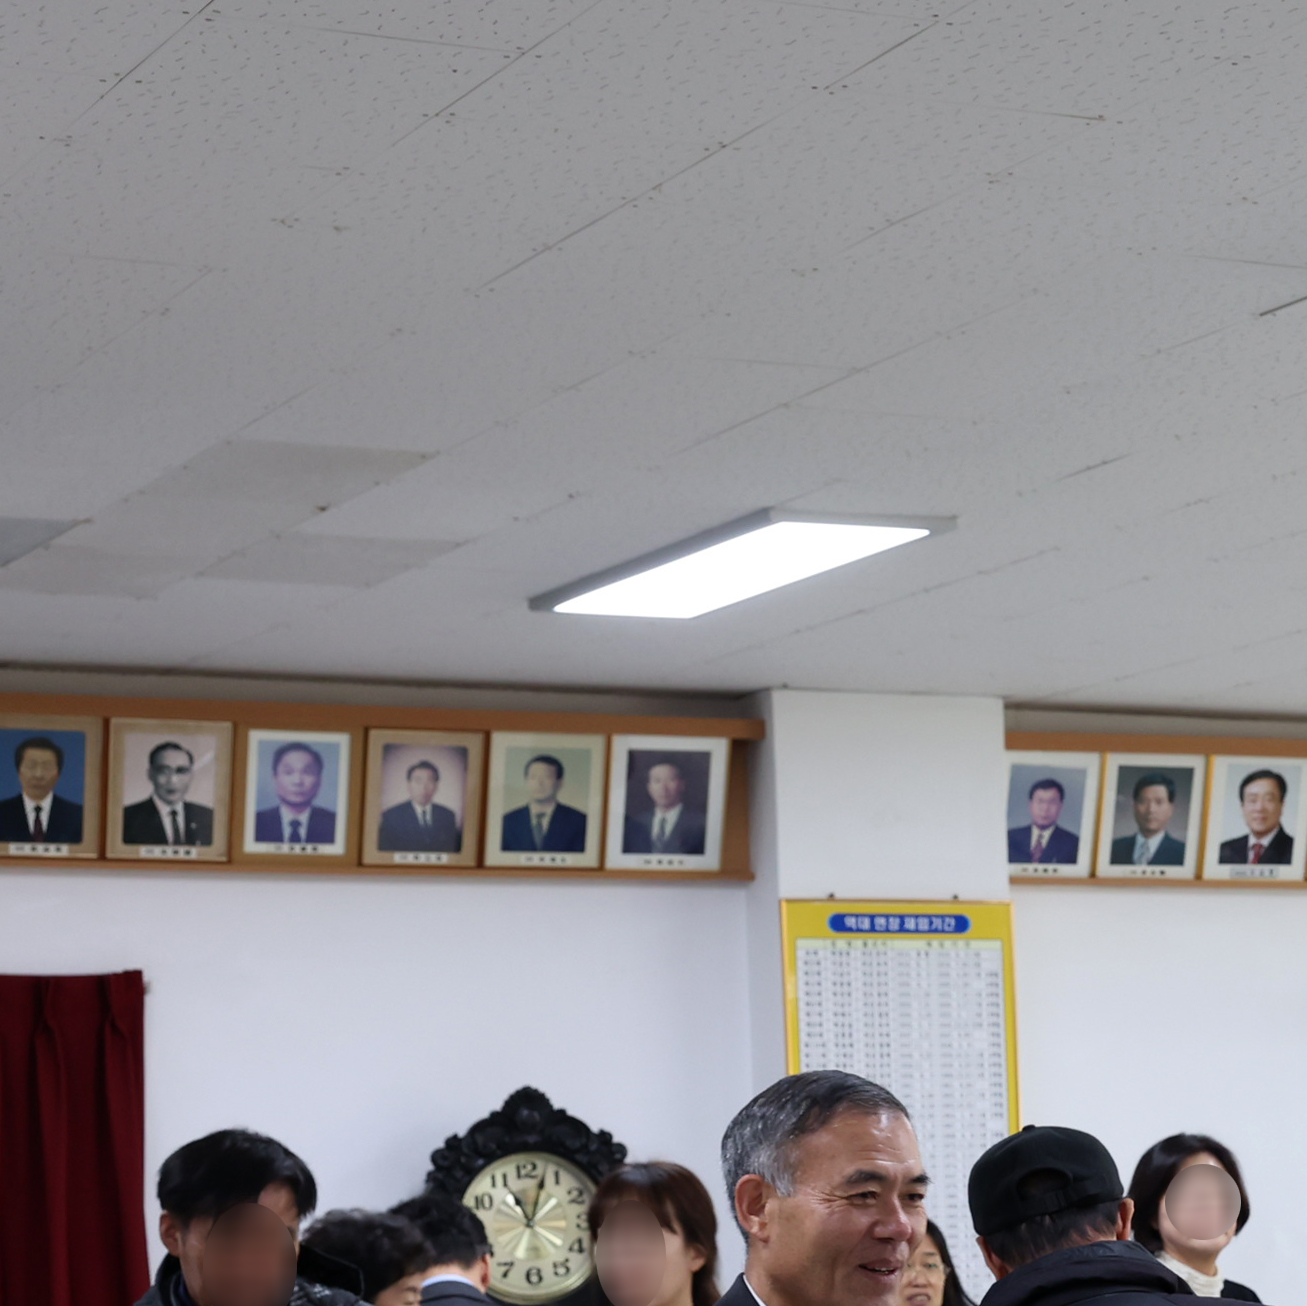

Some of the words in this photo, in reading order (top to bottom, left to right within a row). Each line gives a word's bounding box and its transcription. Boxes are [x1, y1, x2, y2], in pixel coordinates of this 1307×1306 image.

[515, 1162, 537, 1179] 12
[553, 1170, 560, 1185] 1
[490, 1173, 508, 1188] 11
[474, 1193, 493, 1210] 10
[567, 1187, 585, 1204] 2
[569, 1238, 585, 1254] 4
[497, 1261, 515, 1278] 7
[525, 1267, 543, 1285] 6
[552, 1258, 570, 1277] 5
